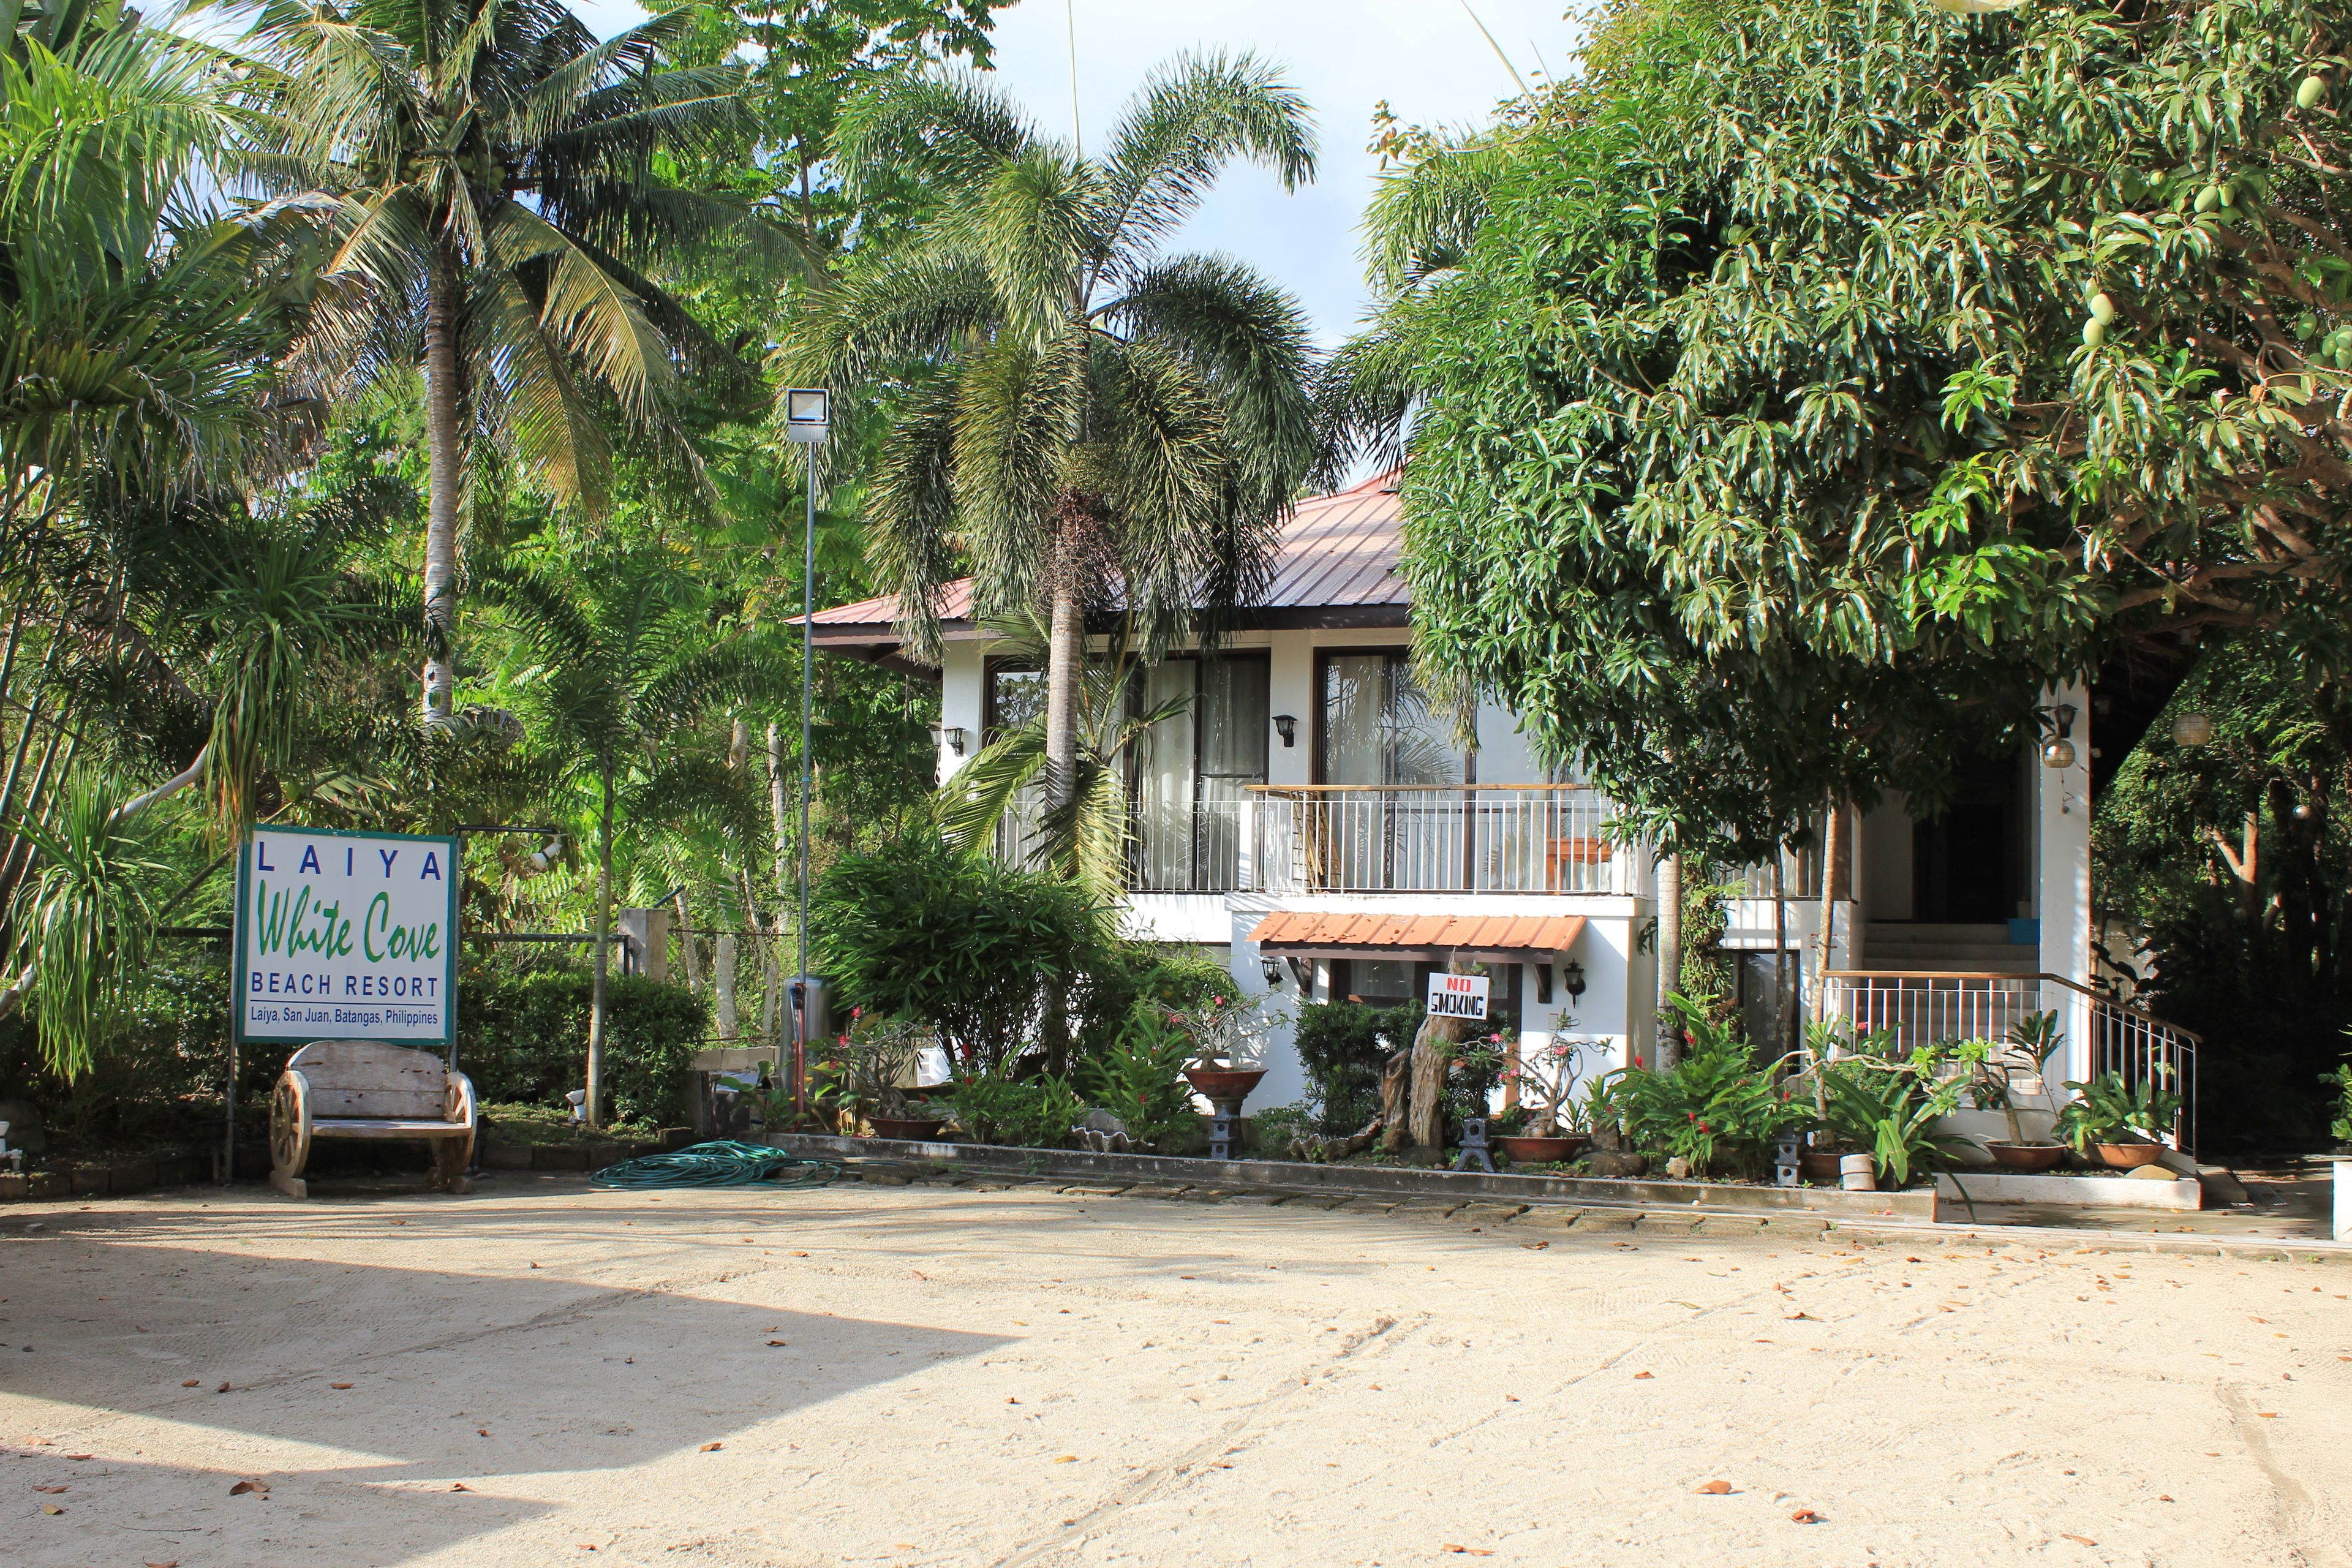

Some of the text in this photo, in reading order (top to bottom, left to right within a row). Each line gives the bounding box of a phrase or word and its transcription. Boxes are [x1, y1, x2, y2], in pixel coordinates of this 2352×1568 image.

[258, 841, 441, 881] LAIYA
[257, 879, 440, 963] White Cove
[251, 971, 437, 997] BEACH RESORT
[1446, 977, 1471, 992] NO
[251, 1006, 438, 1027] Laiya, San Juan, Batangas, Philippines
[1431, 992, 1483, 1016] SMOKING
